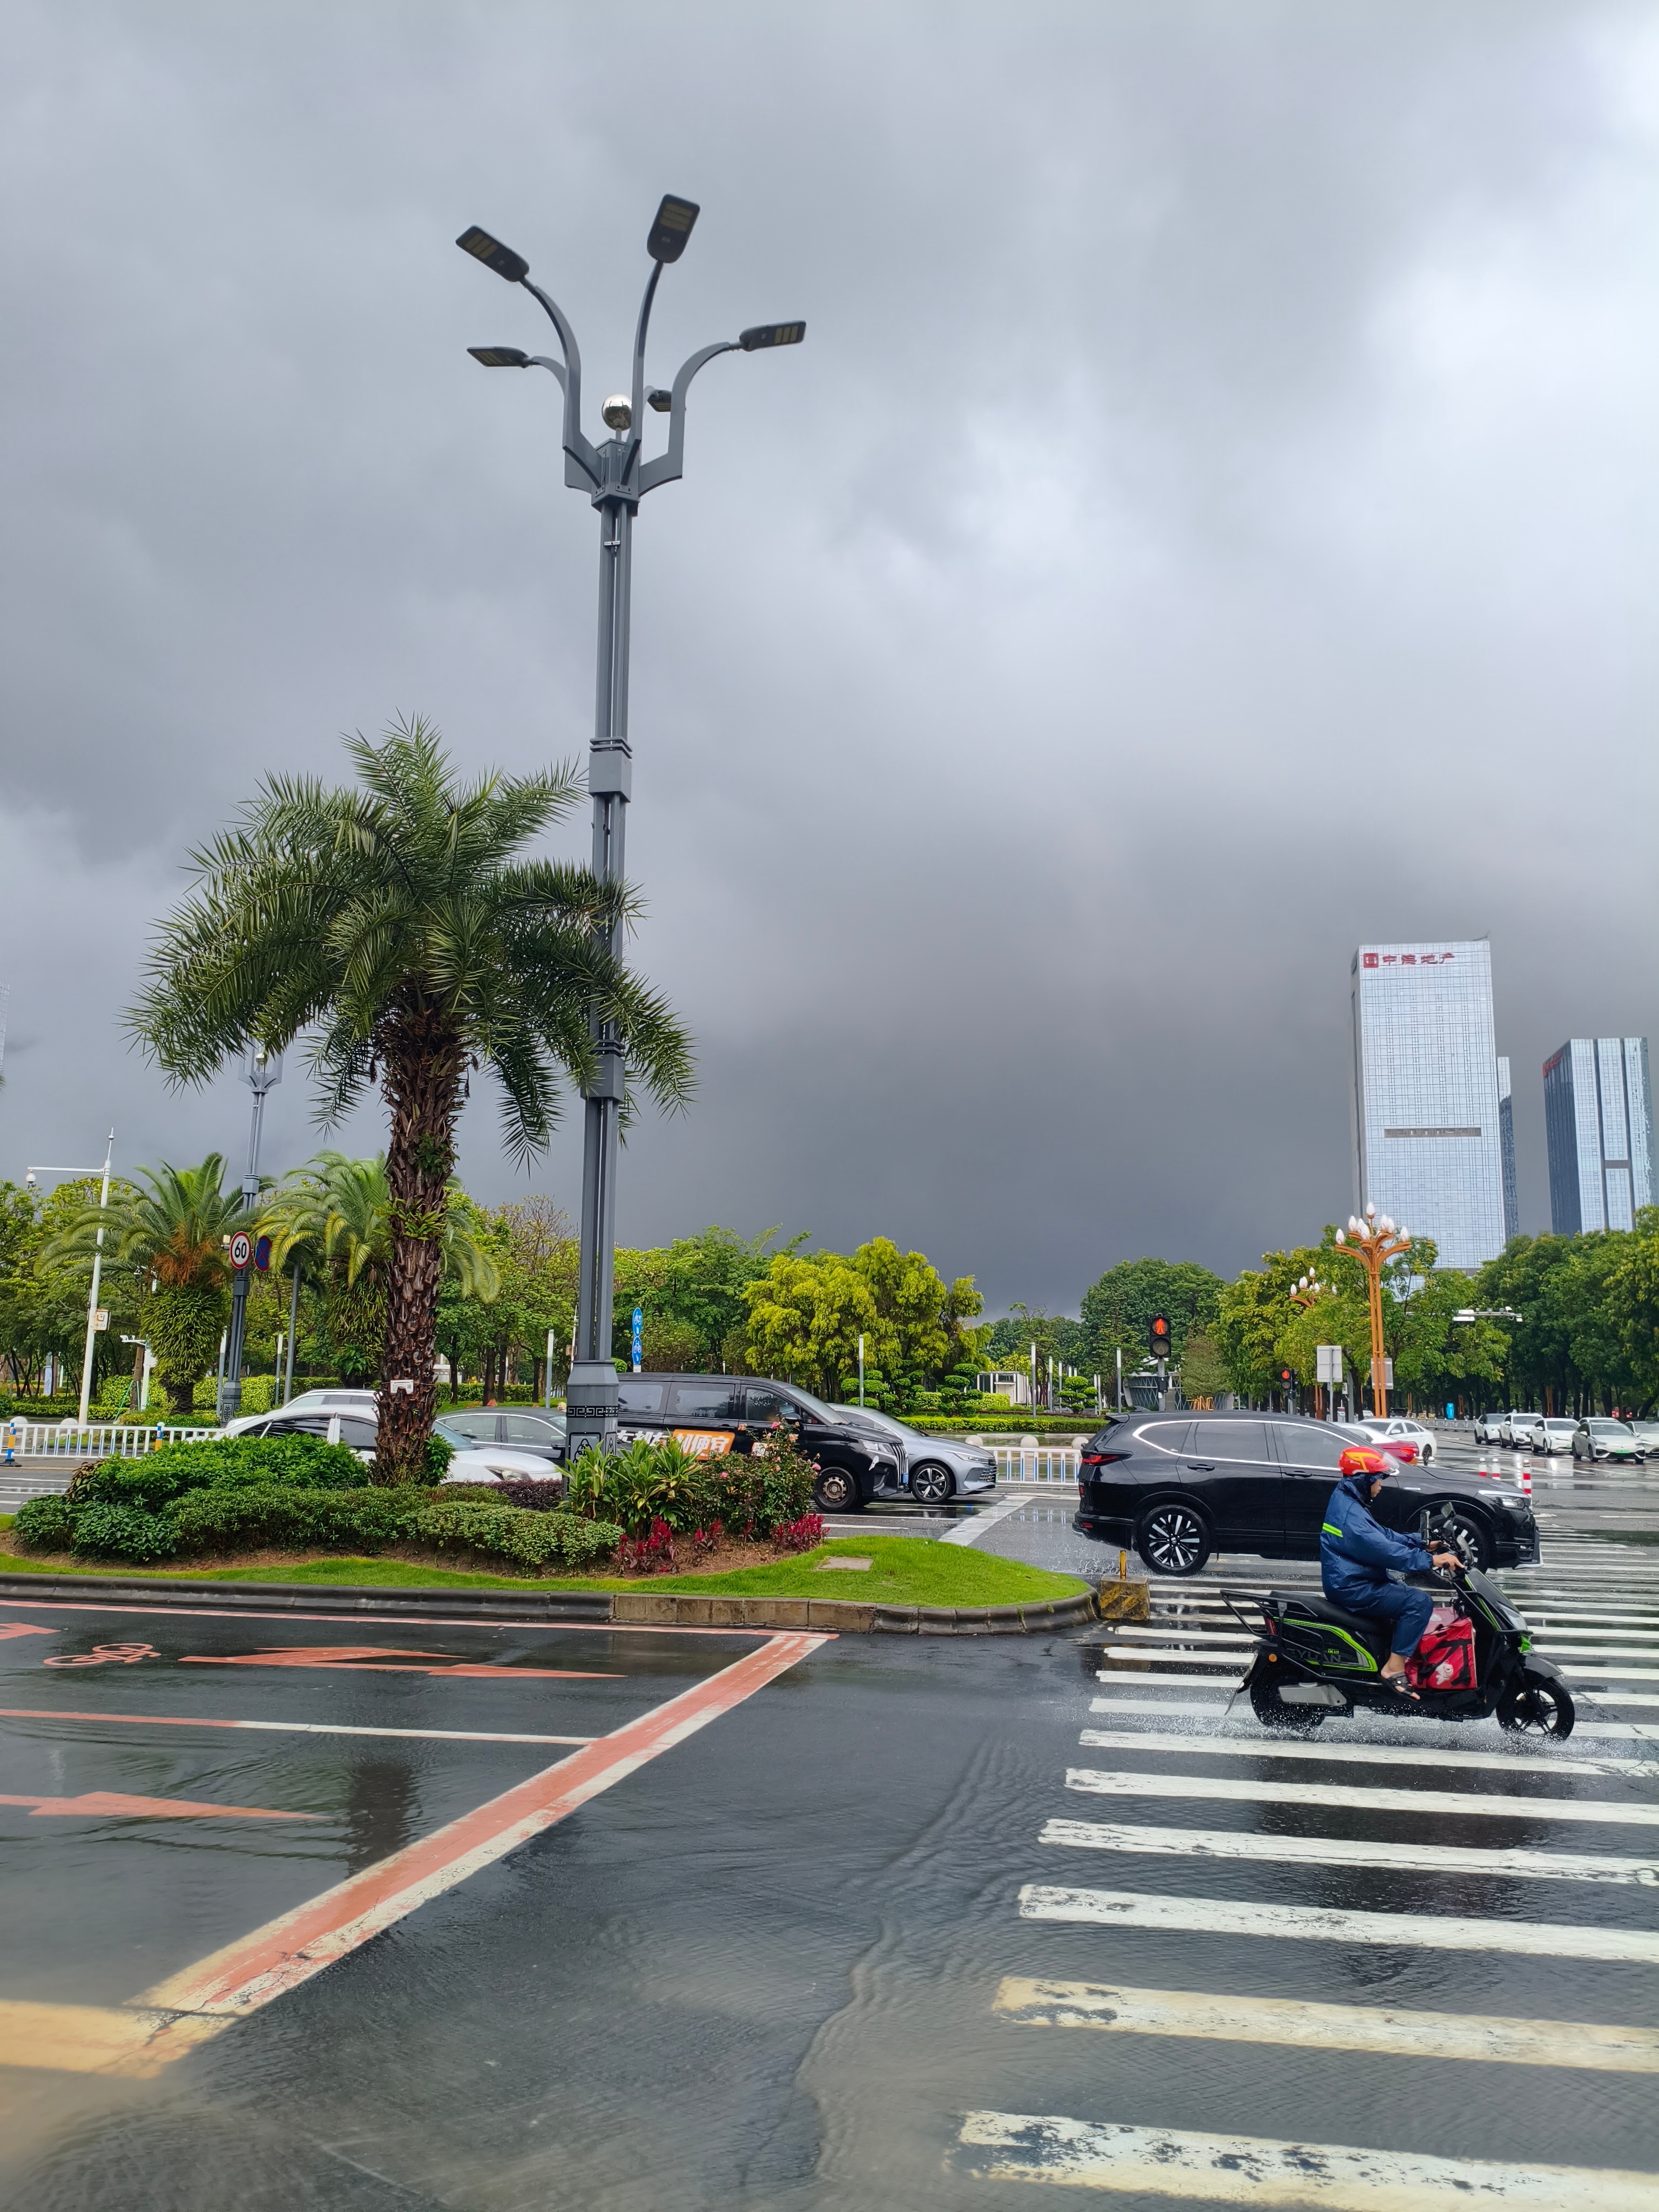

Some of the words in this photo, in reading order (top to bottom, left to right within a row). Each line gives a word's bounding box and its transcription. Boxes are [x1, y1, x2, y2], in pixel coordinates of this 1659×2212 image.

[1382, 953, 1455, 965] 中海地产
[234, 1241, 247, 1259] 60
